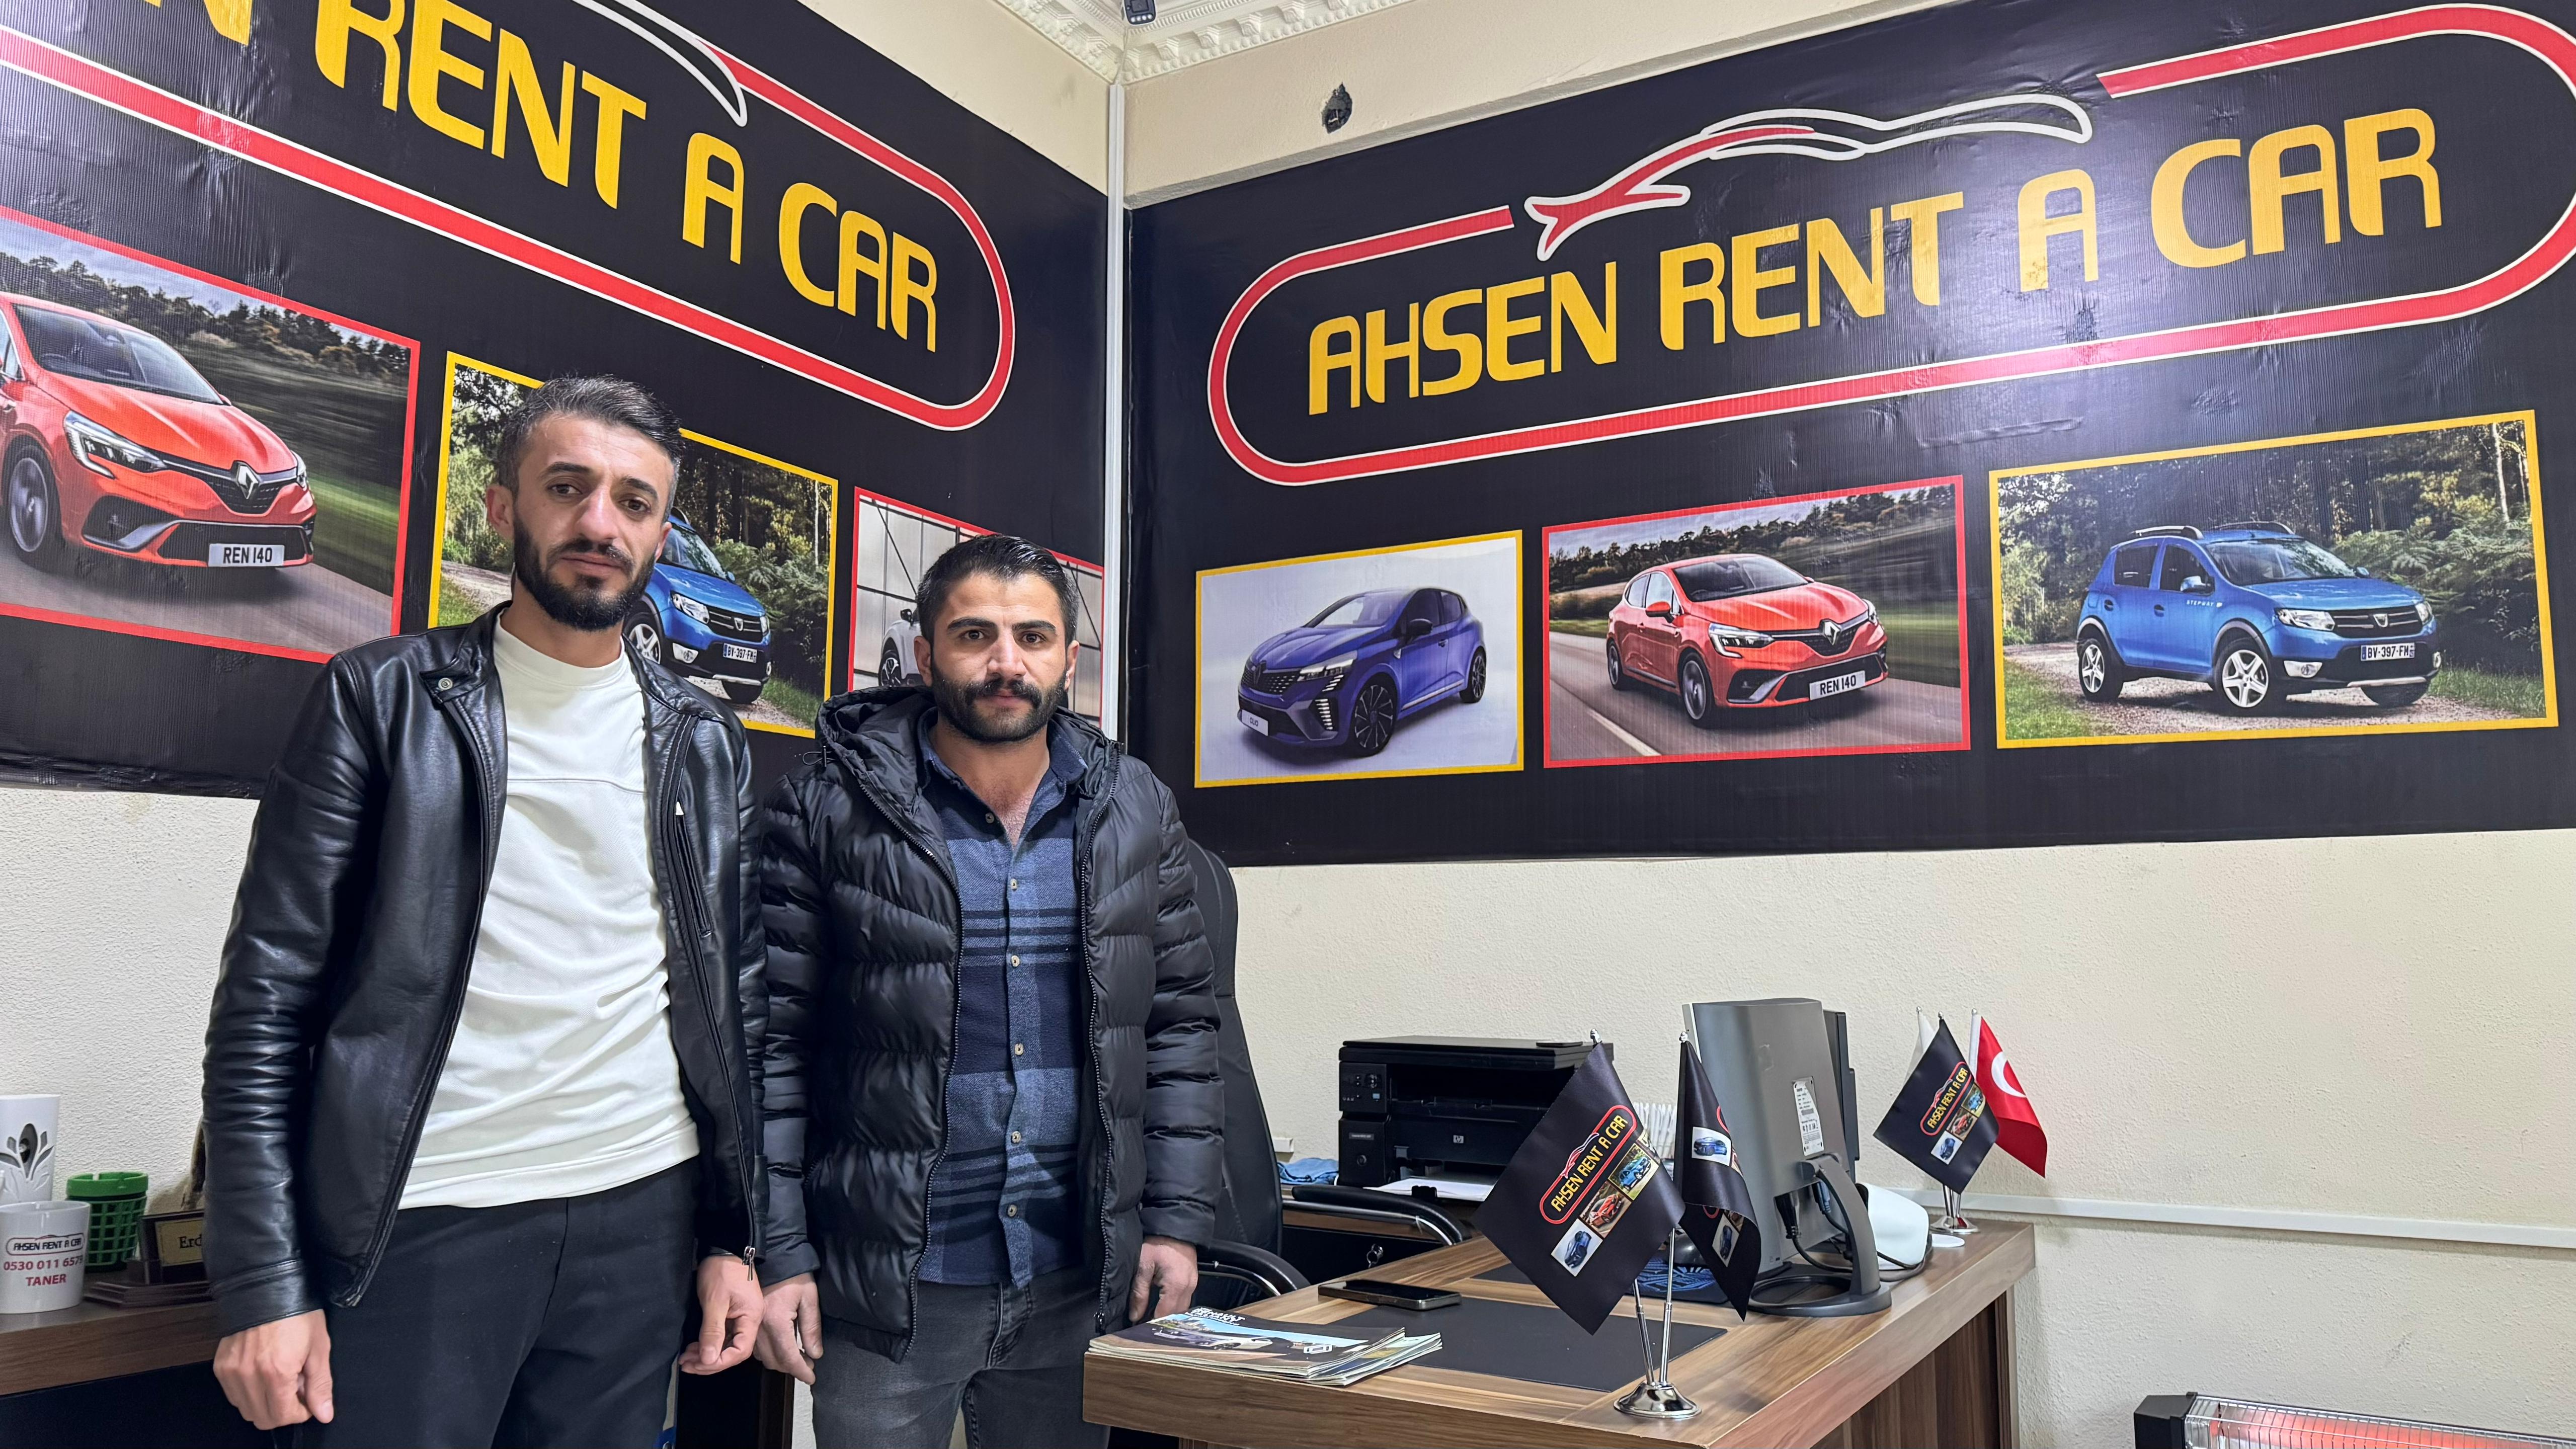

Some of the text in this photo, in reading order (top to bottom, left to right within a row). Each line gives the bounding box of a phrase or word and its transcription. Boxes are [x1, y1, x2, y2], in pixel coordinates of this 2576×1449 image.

[315, 0, 937, 352] RENT A CAR
[1309, 108, 2442, 415] AHSEN RENT A CAR
[223, 547, 272, 564] REN 140
[1820, 675, 1856, 695] REN 140
[1926, 1067, 1968, 1129] AHSEN RENT A CAR
[1551, 1115, 1628, 1212] AHSEN RENT A CAR
[14, 1243, 40, 1251] AHSEN
[42, 1241, 63, 1250] RENT
[4, 1261, 34, 1270] 0530
[37, 1259, 59, 1269] 011
[26, 1273, 67, 1286] TANER
